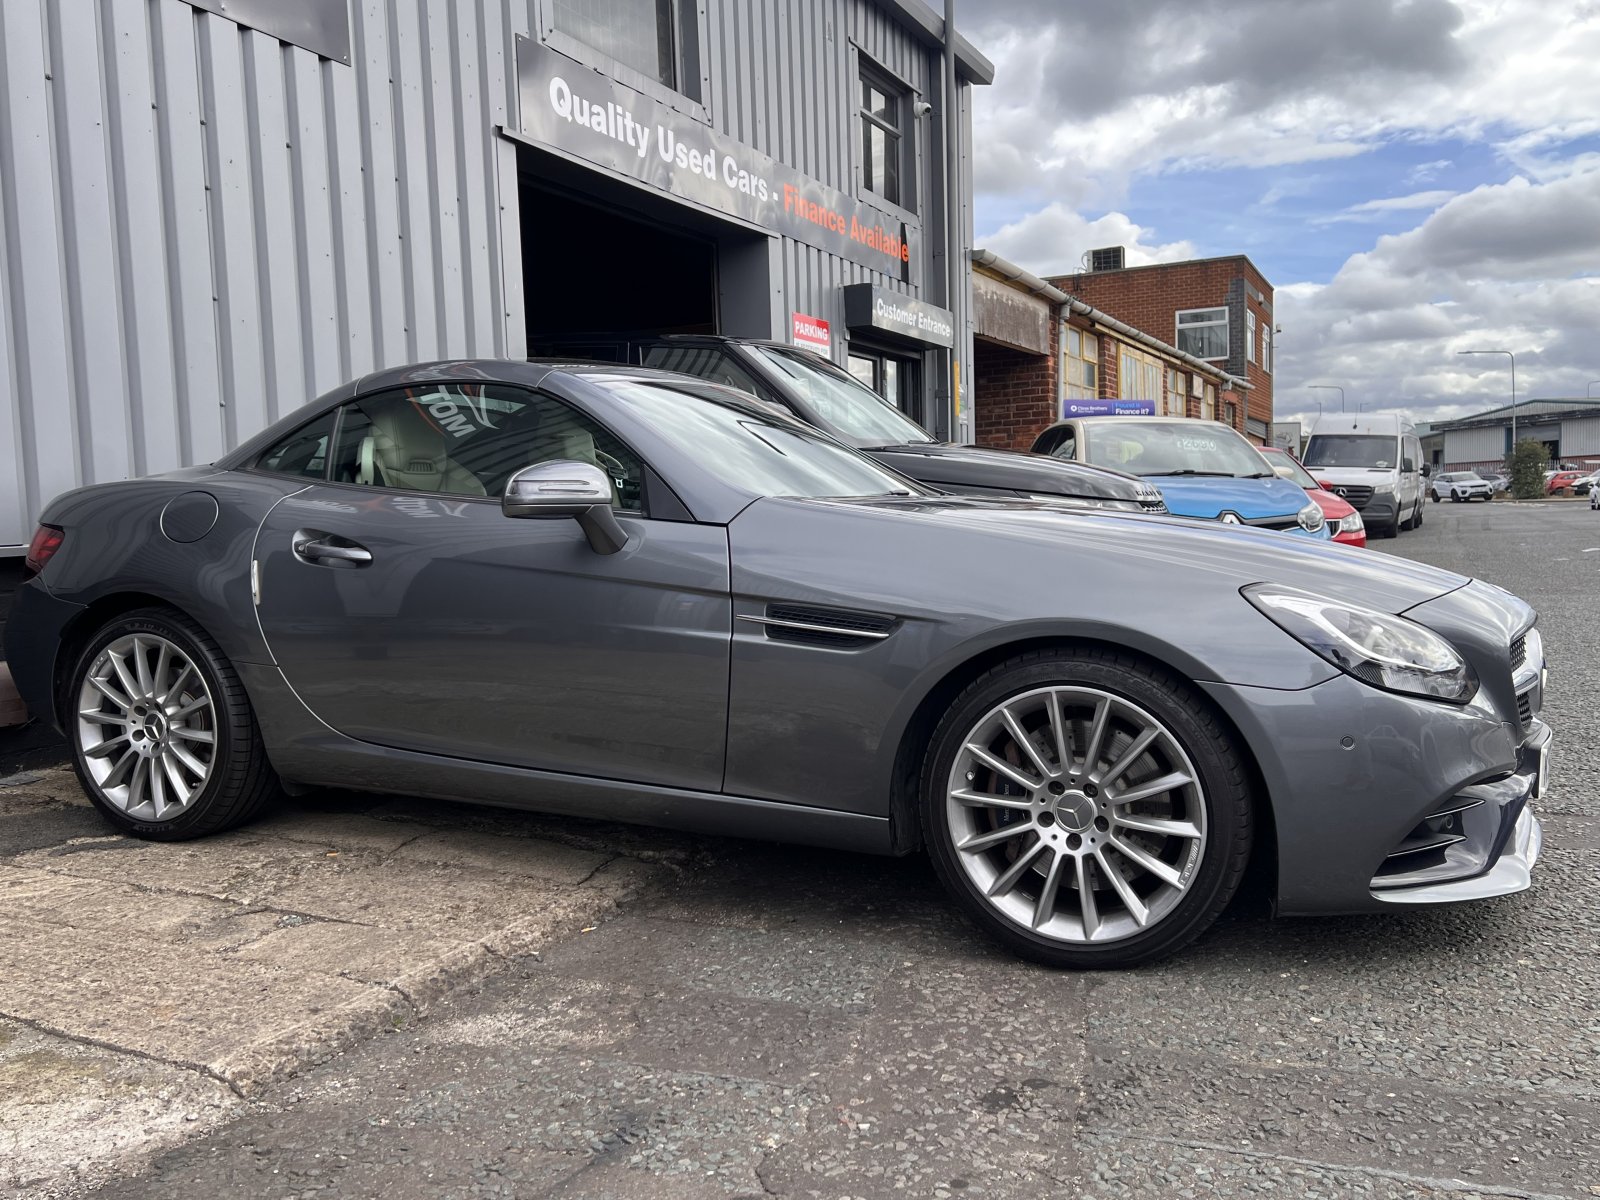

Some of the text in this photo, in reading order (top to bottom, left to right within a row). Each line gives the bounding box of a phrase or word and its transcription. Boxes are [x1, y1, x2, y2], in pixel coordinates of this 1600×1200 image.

[550, 77, 649, 158] Quality
[657, 125, 717, 181] Used
[722, 155, 768, 201] Cars
[783, 183, 847, 236] Finance
[850, 215, 910, 263] Available
[795, 321, 828, 341] PARKING
[876, 298, 951, 337] Customer Entrance
